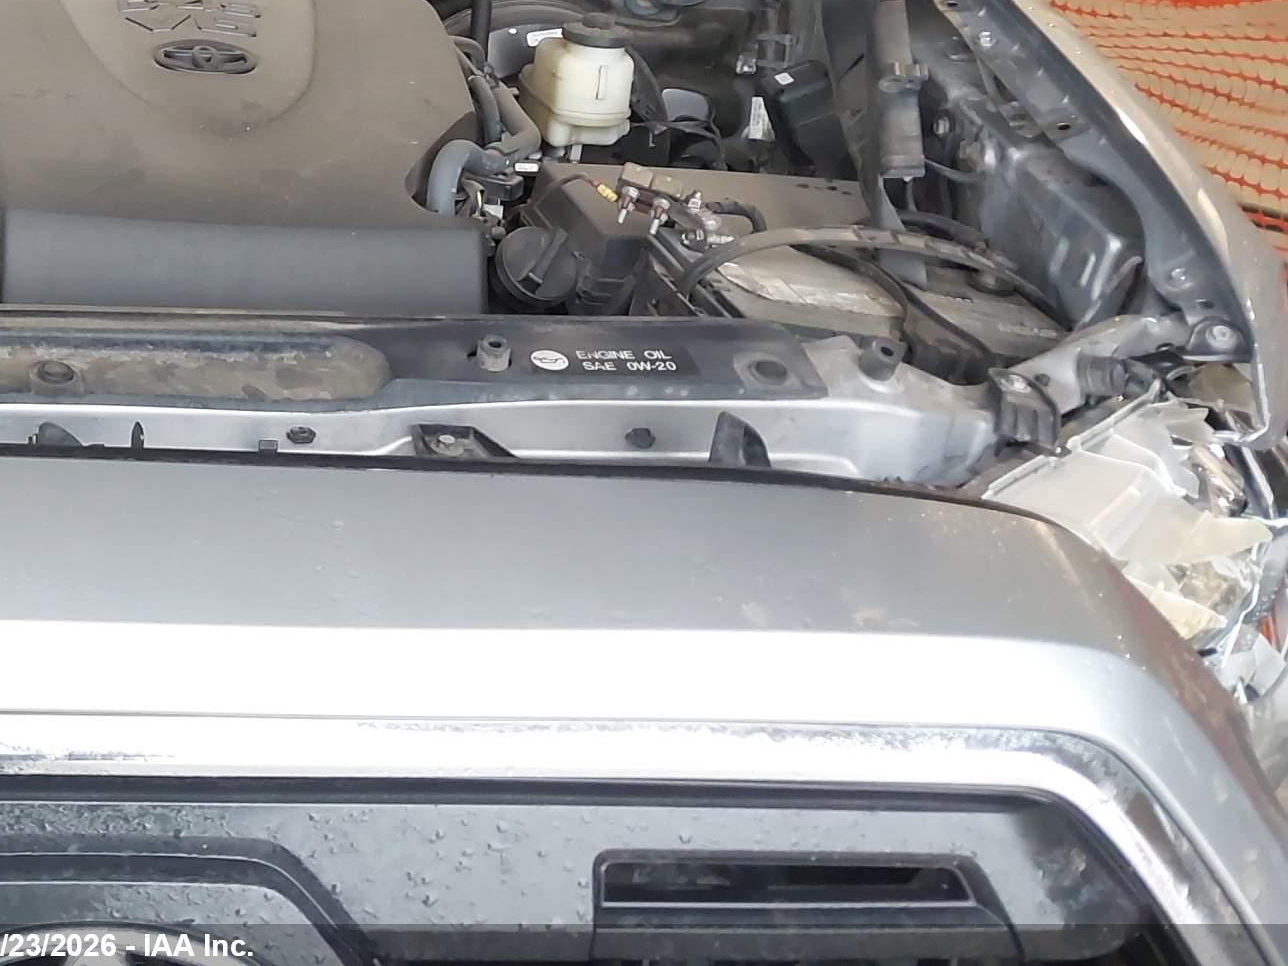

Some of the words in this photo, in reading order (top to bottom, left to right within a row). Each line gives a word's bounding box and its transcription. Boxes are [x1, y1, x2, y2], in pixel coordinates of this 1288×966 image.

[575, 349, 636, 360] ENGINE
[643, 349, 672, 360] OIL
[581, 361, 616, 372] SAE
[626, 361, 677, 372] 0W-20
